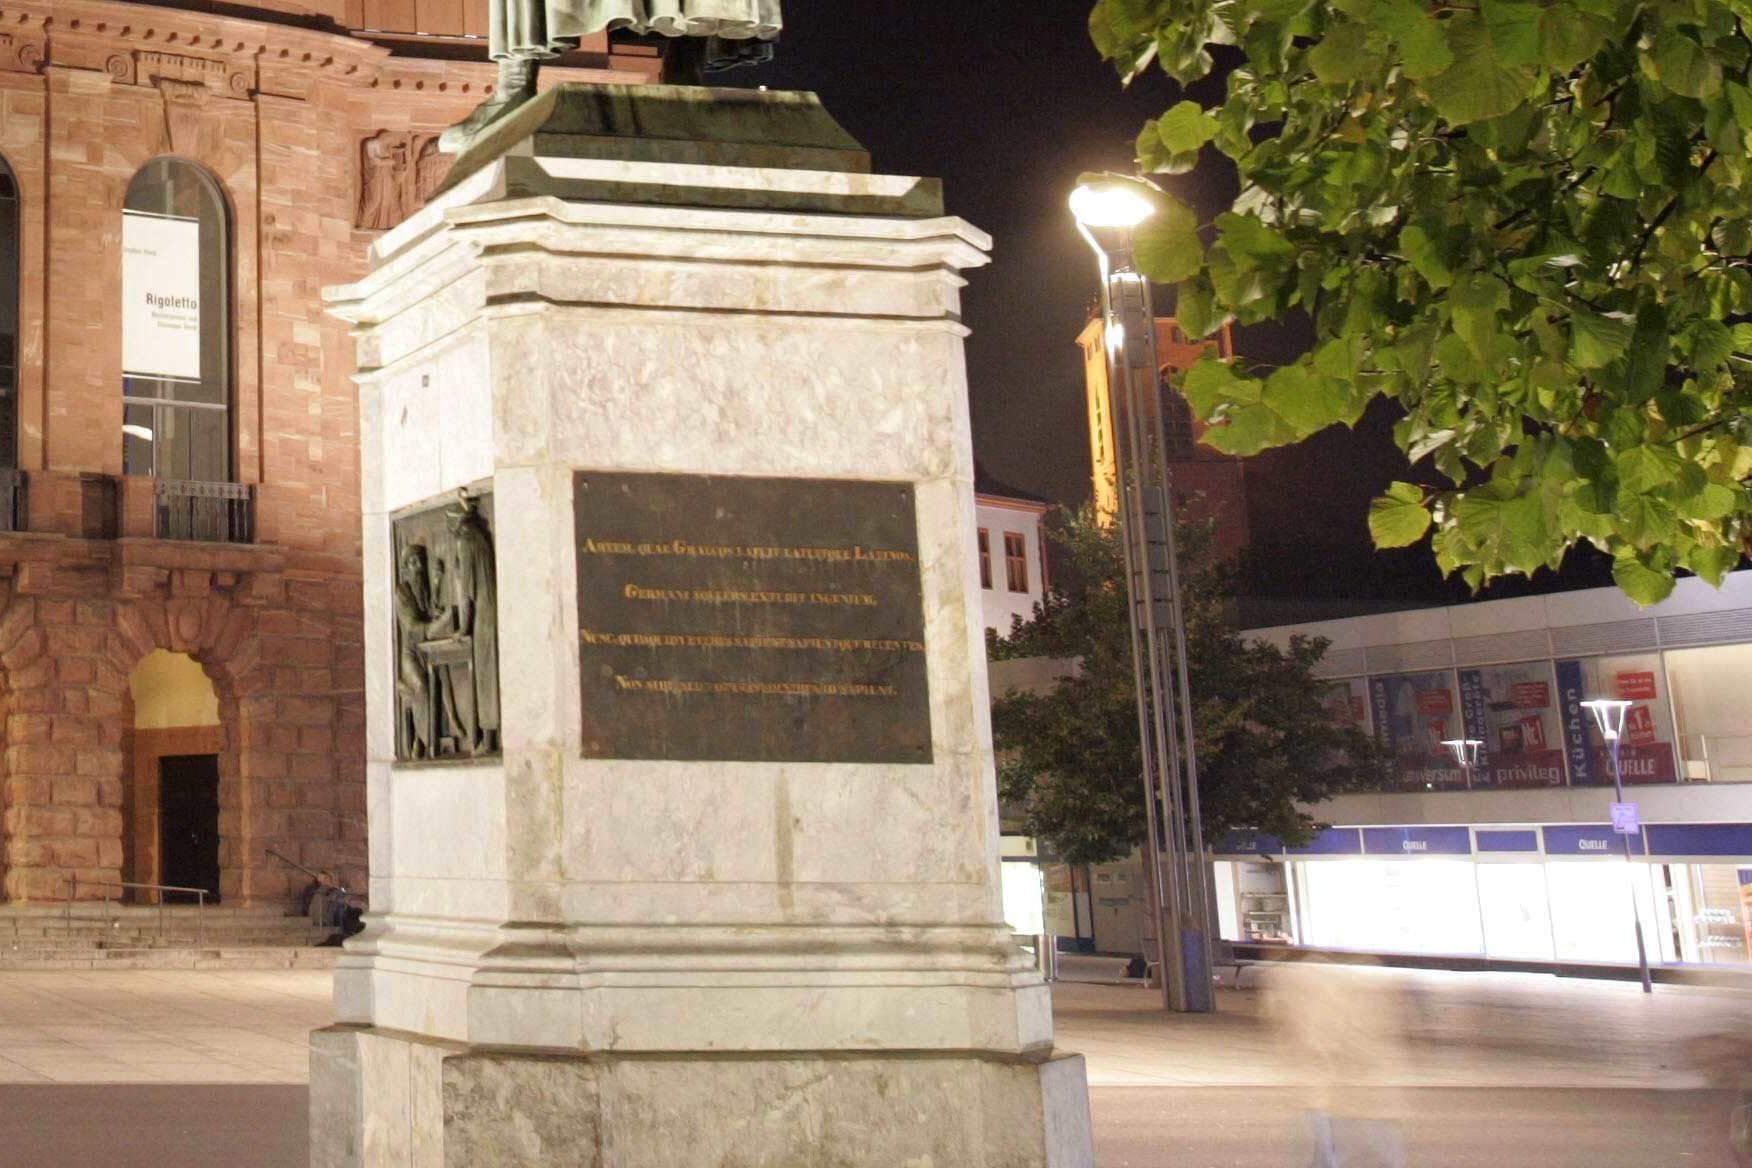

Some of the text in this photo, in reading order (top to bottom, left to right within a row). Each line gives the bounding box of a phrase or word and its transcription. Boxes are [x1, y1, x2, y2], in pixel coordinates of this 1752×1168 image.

[146, 293, 197, 310] Rigoletto
[1567, 687, 1587, 778] Küchen
[1497, 763, 1561, 785] privileg
